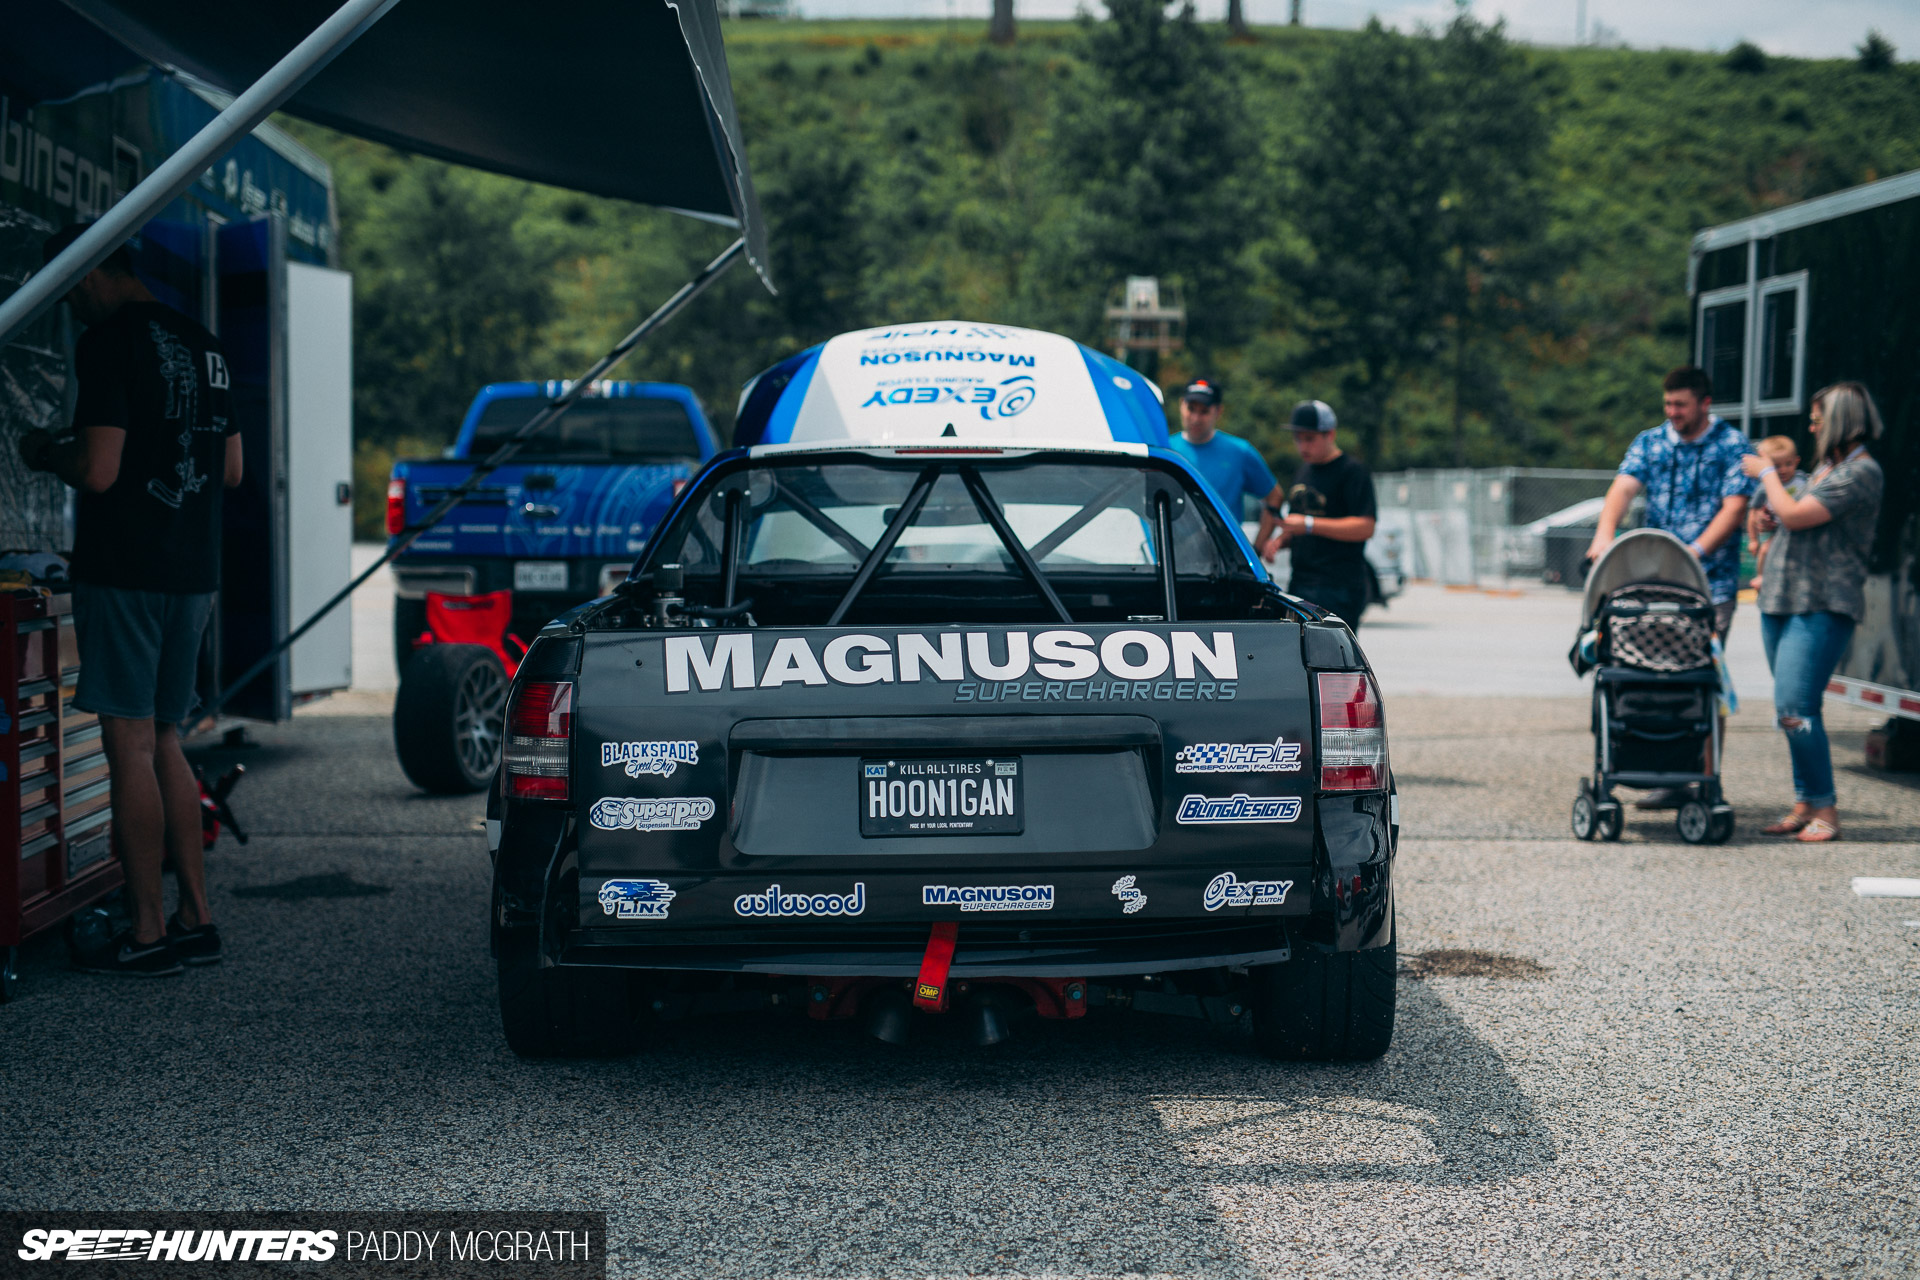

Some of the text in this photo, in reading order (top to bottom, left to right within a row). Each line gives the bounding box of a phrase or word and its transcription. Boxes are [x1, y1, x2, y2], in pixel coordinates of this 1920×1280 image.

[860, 351, 1035, 367] MAGNUSON
[861, 386, 997, 408] EXEDY
[665, 630, 1239, 692] MAGNUSON
[954, 680, 1238, 702] SUPERCHARGERS
[602, 742, 697, 765] BLACKSPADE
[627, 758, 675, 775] Speed Shop
[866, 766, 885, 776] KAT
[900, 763, 981, 775] KILL ALL TIRES
[1177, 763, 1249, 771] HORSEPOWER
[869, 778, 1014, 818] HOON1GAN
[925, 887, 1053, 903] MAGNUSON
[1120, 890, 1139, 899] PPG
[1224, 883, 1290, 898] EXEDY
[735, 883, 865, 915] wilwood
[962, 901, 1052, 910] SUPERCHARGERS
[618, 903, 667, 914] LINK
[919, 986, 939, 997] OMP
